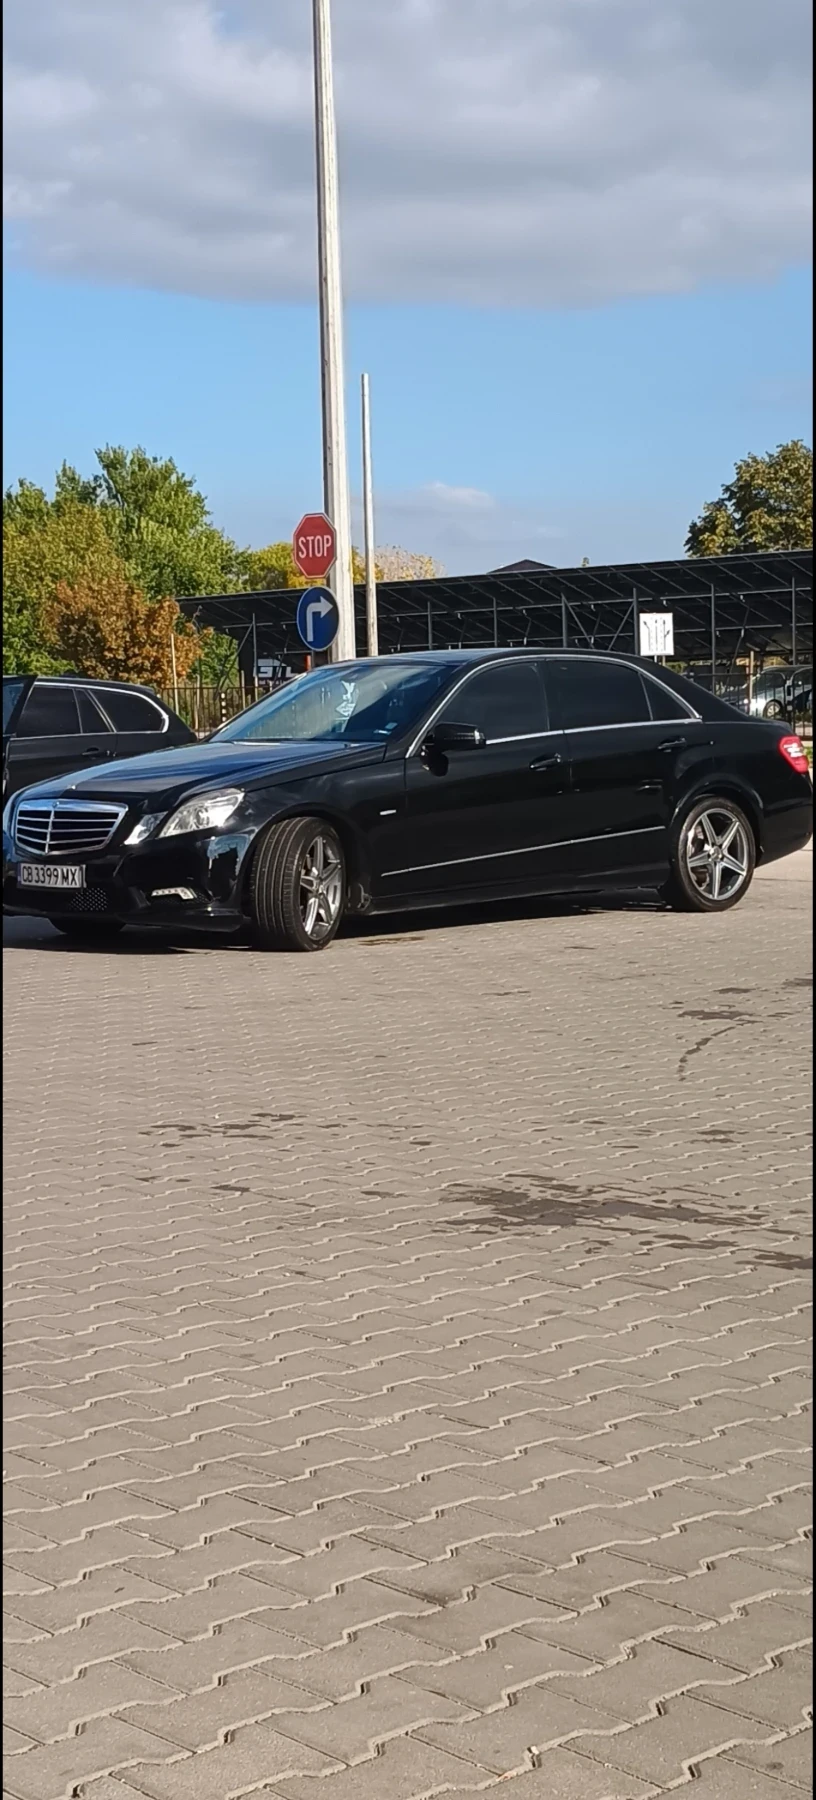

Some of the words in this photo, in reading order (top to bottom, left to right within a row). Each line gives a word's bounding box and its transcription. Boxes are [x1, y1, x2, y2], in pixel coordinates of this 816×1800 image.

[298, 534, 332, 559] STOP
[22, 865, 33, 883] CB
[34, 866, 59, 885] 3399
[61, 868, 78, 886] MX
